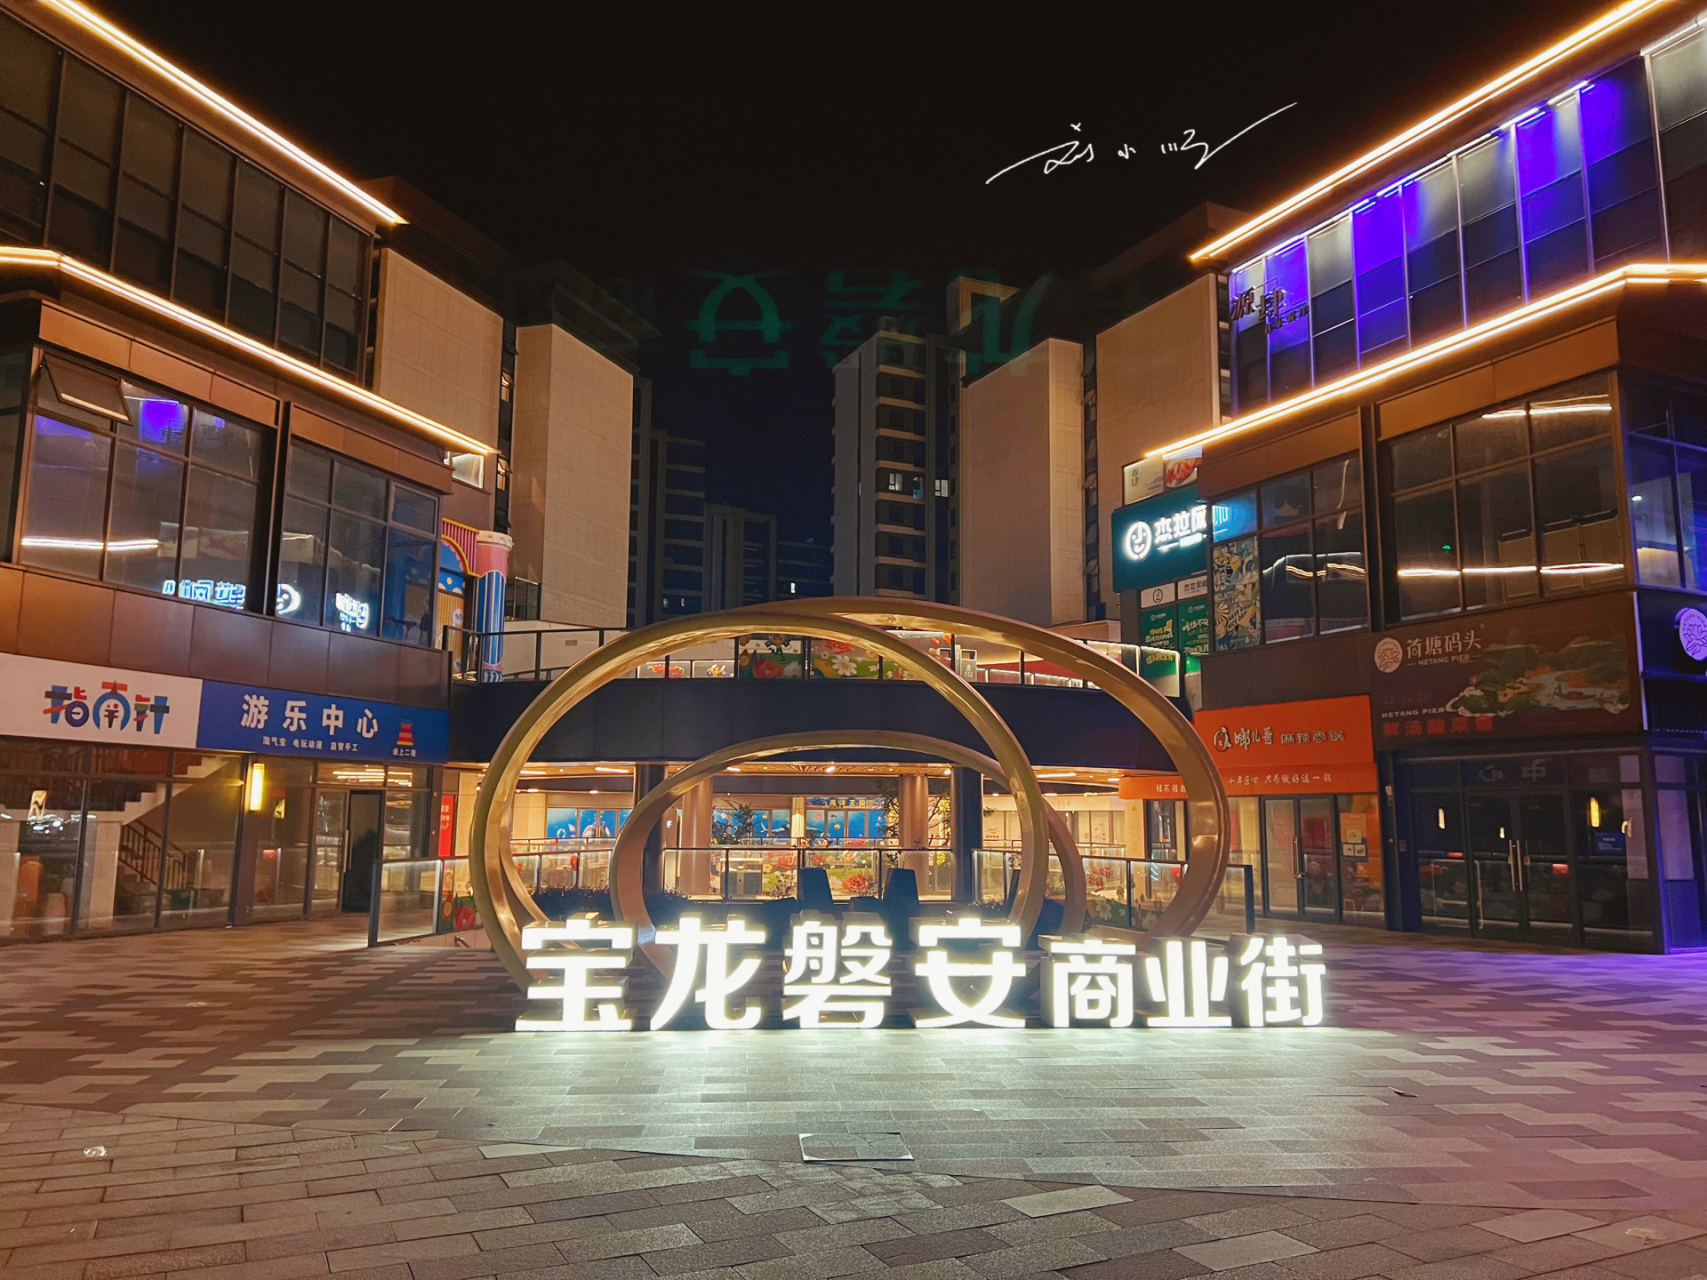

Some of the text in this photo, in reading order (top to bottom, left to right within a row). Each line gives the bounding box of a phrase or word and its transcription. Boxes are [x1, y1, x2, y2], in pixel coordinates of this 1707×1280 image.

[1406, 630, 1482, 659] 荷塘码头
[1418, 653, 1470, 666] HETANG PIER
[43, 680, 170, 734] 指南针
[240, 693, 379, 739] 游乐中心
[1381, 706, 1445, 719] HETANG PIER
[262, 736, 358, 752] 淘气宝 电玩动漫 益智手工
[514, 918, 1327, 1030] 宝龙磐安商业街
